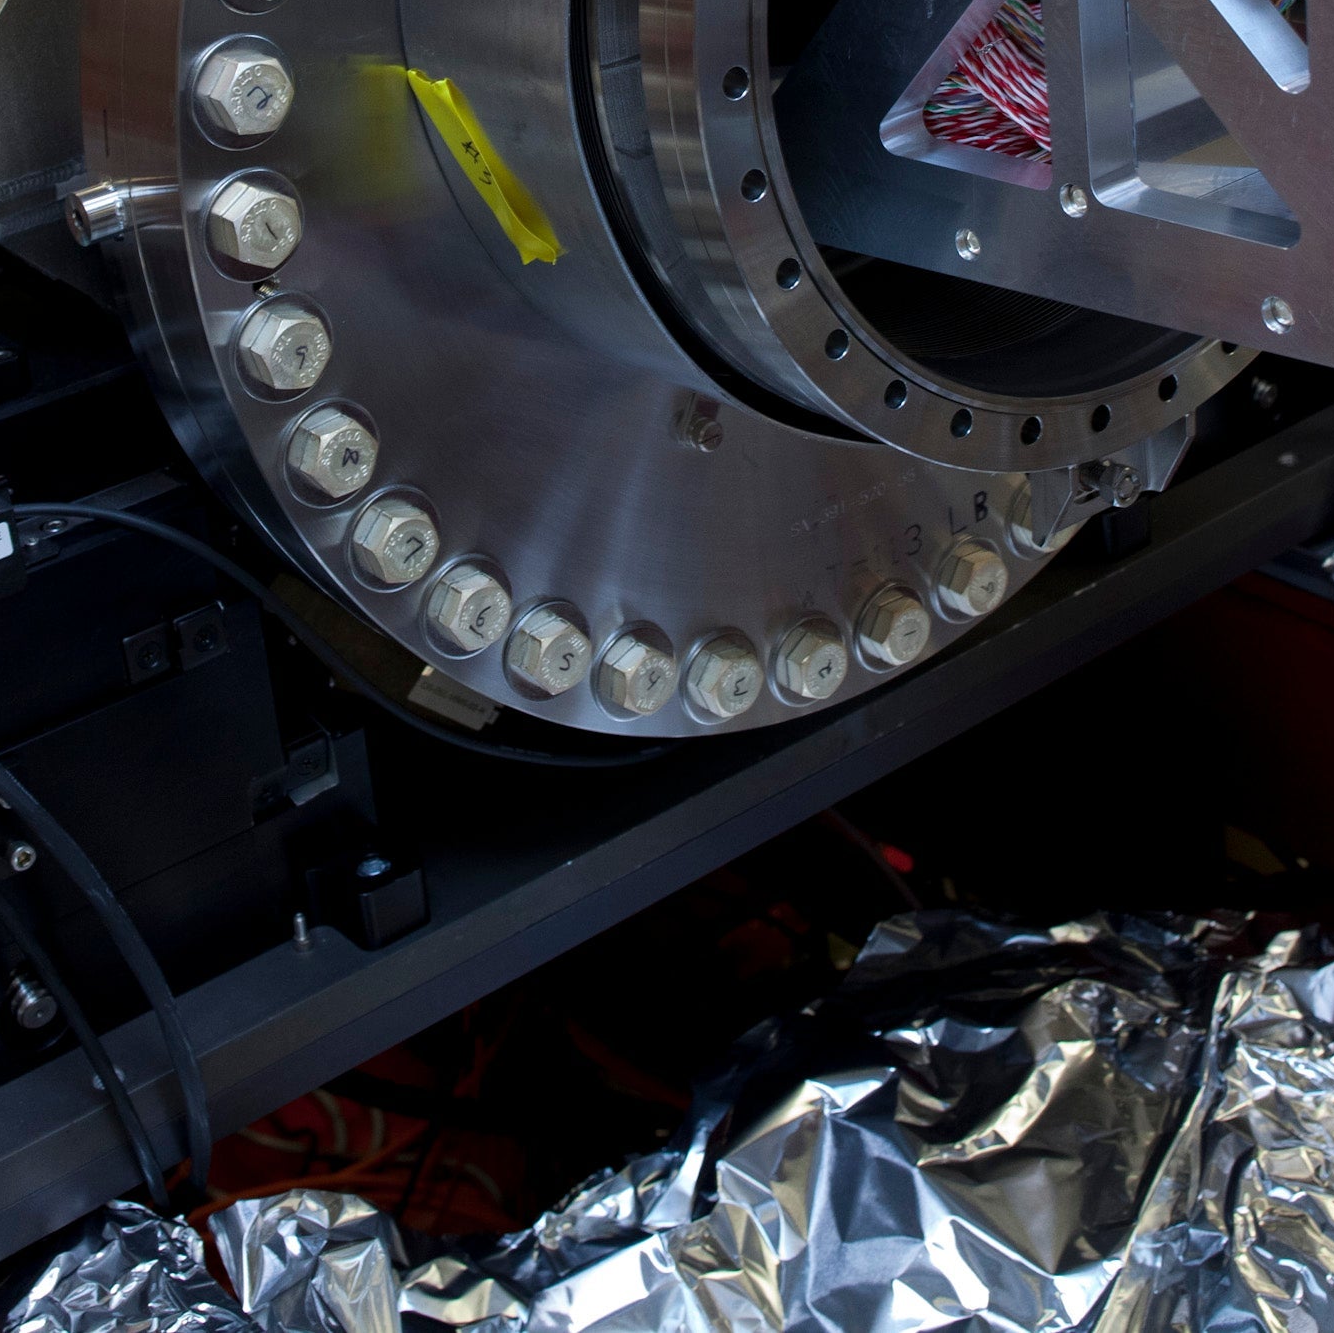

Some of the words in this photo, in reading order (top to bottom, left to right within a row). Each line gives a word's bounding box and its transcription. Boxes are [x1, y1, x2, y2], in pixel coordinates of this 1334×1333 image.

[246, 85, 273, 111] 2
[341, 447, 360, 468] 8
[403, 536, 425, 565] 7
[558, 652, 576, 672] 5
[646, 670, 662, 691] 4
